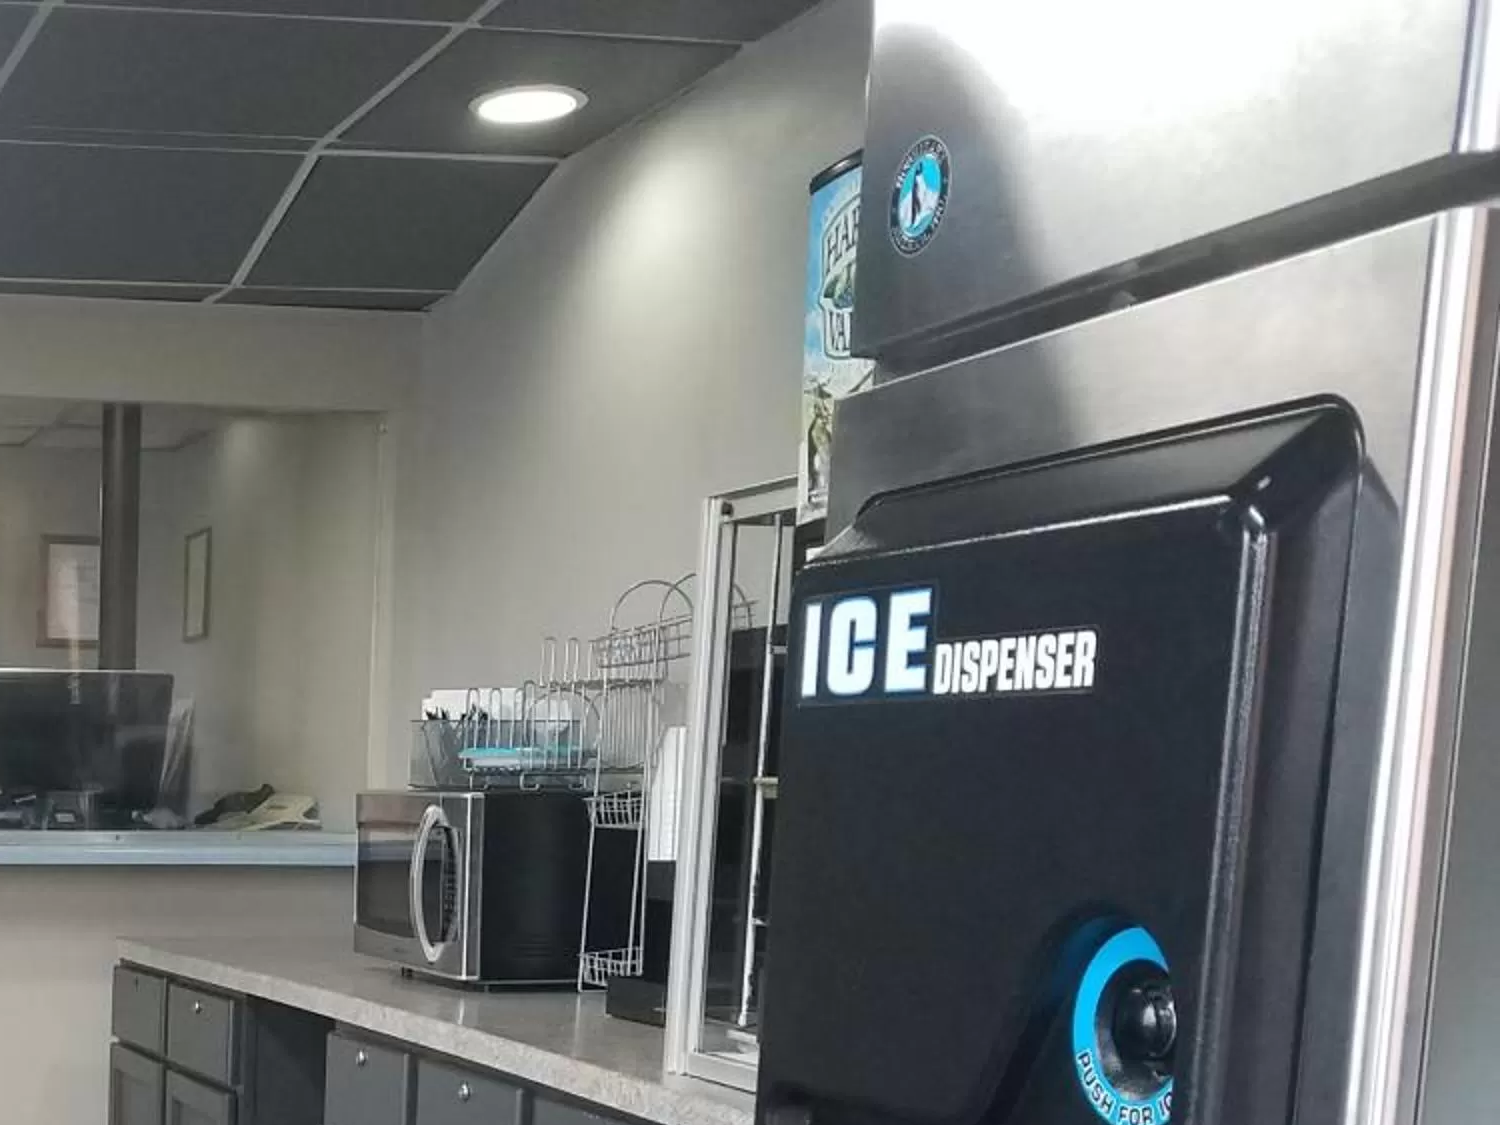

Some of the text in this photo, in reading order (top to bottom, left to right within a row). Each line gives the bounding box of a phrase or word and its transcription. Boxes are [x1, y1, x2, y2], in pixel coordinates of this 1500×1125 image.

[801, 588, 1097, 698] ICE DISPENSER
[1077, 1050, 1114, 1113] PUSH
[1117, 1104, 1153, 1125] FOR
